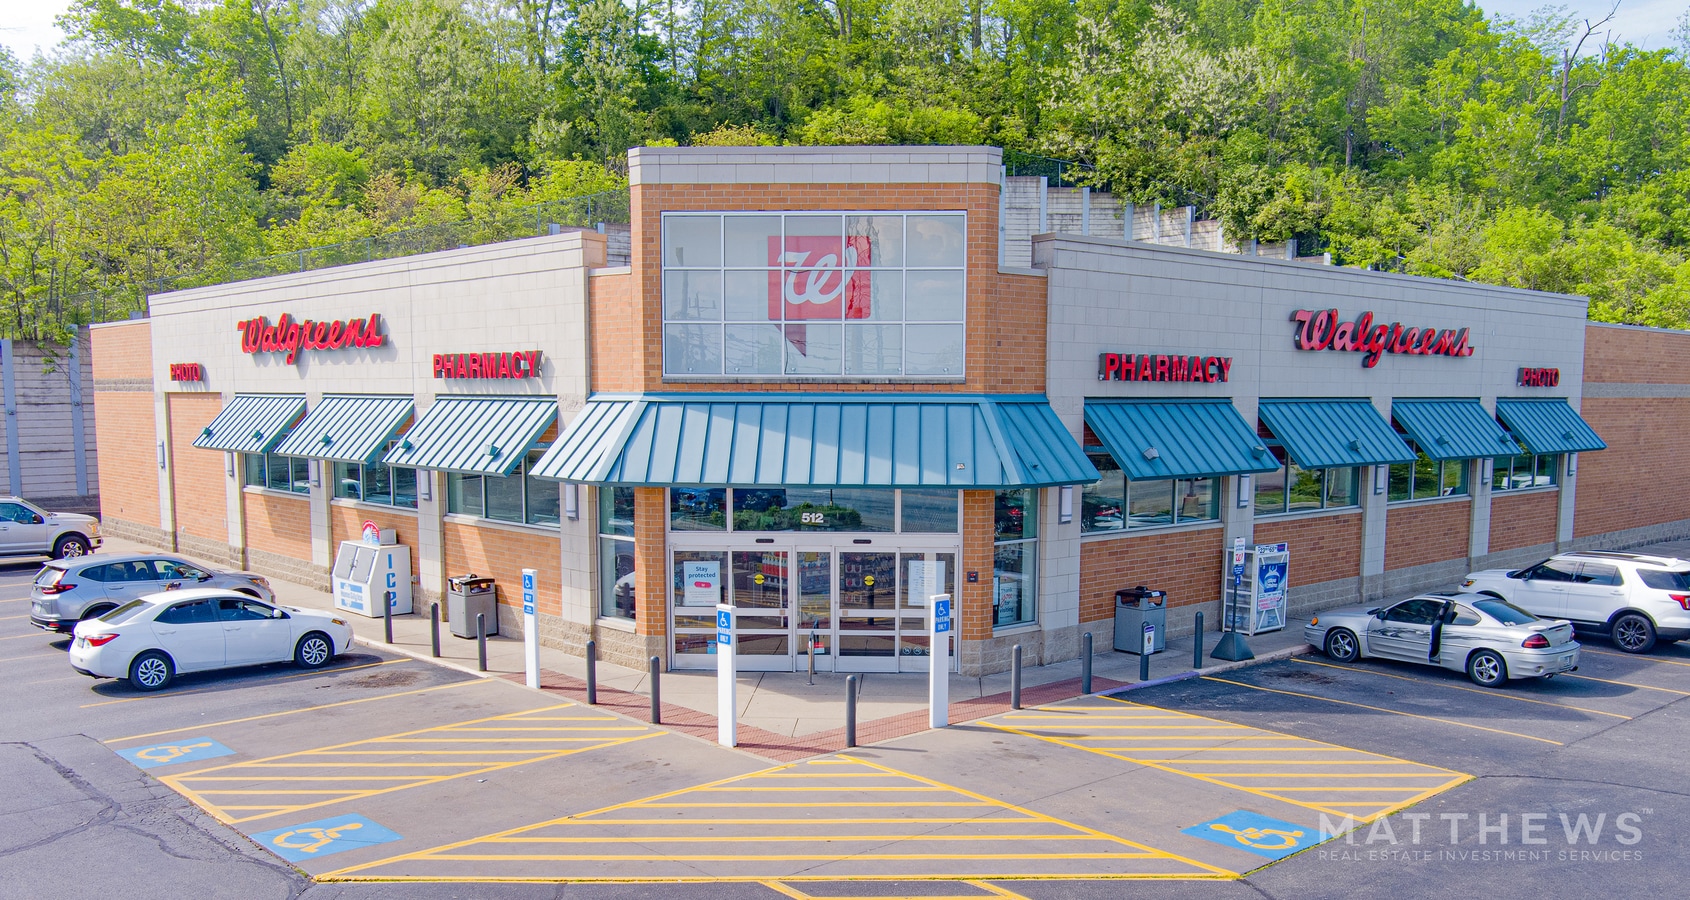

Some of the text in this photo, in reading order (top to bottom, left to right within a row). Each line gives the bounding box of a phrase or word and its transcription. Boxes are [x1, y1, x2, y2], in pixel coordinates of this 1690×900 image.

[237, 312, 385, 365] Walgreens
[1292, 308, 1474, 368] Walgreens
[169, 362, 202, 382] PHOTO
[432, 350, 541, 380] PHARMACY
[1101, 352, 1233, 383] PHARMACY
[1519, 367, 1560, 387] PHOTO
[801, 512, 824, 523] 512
